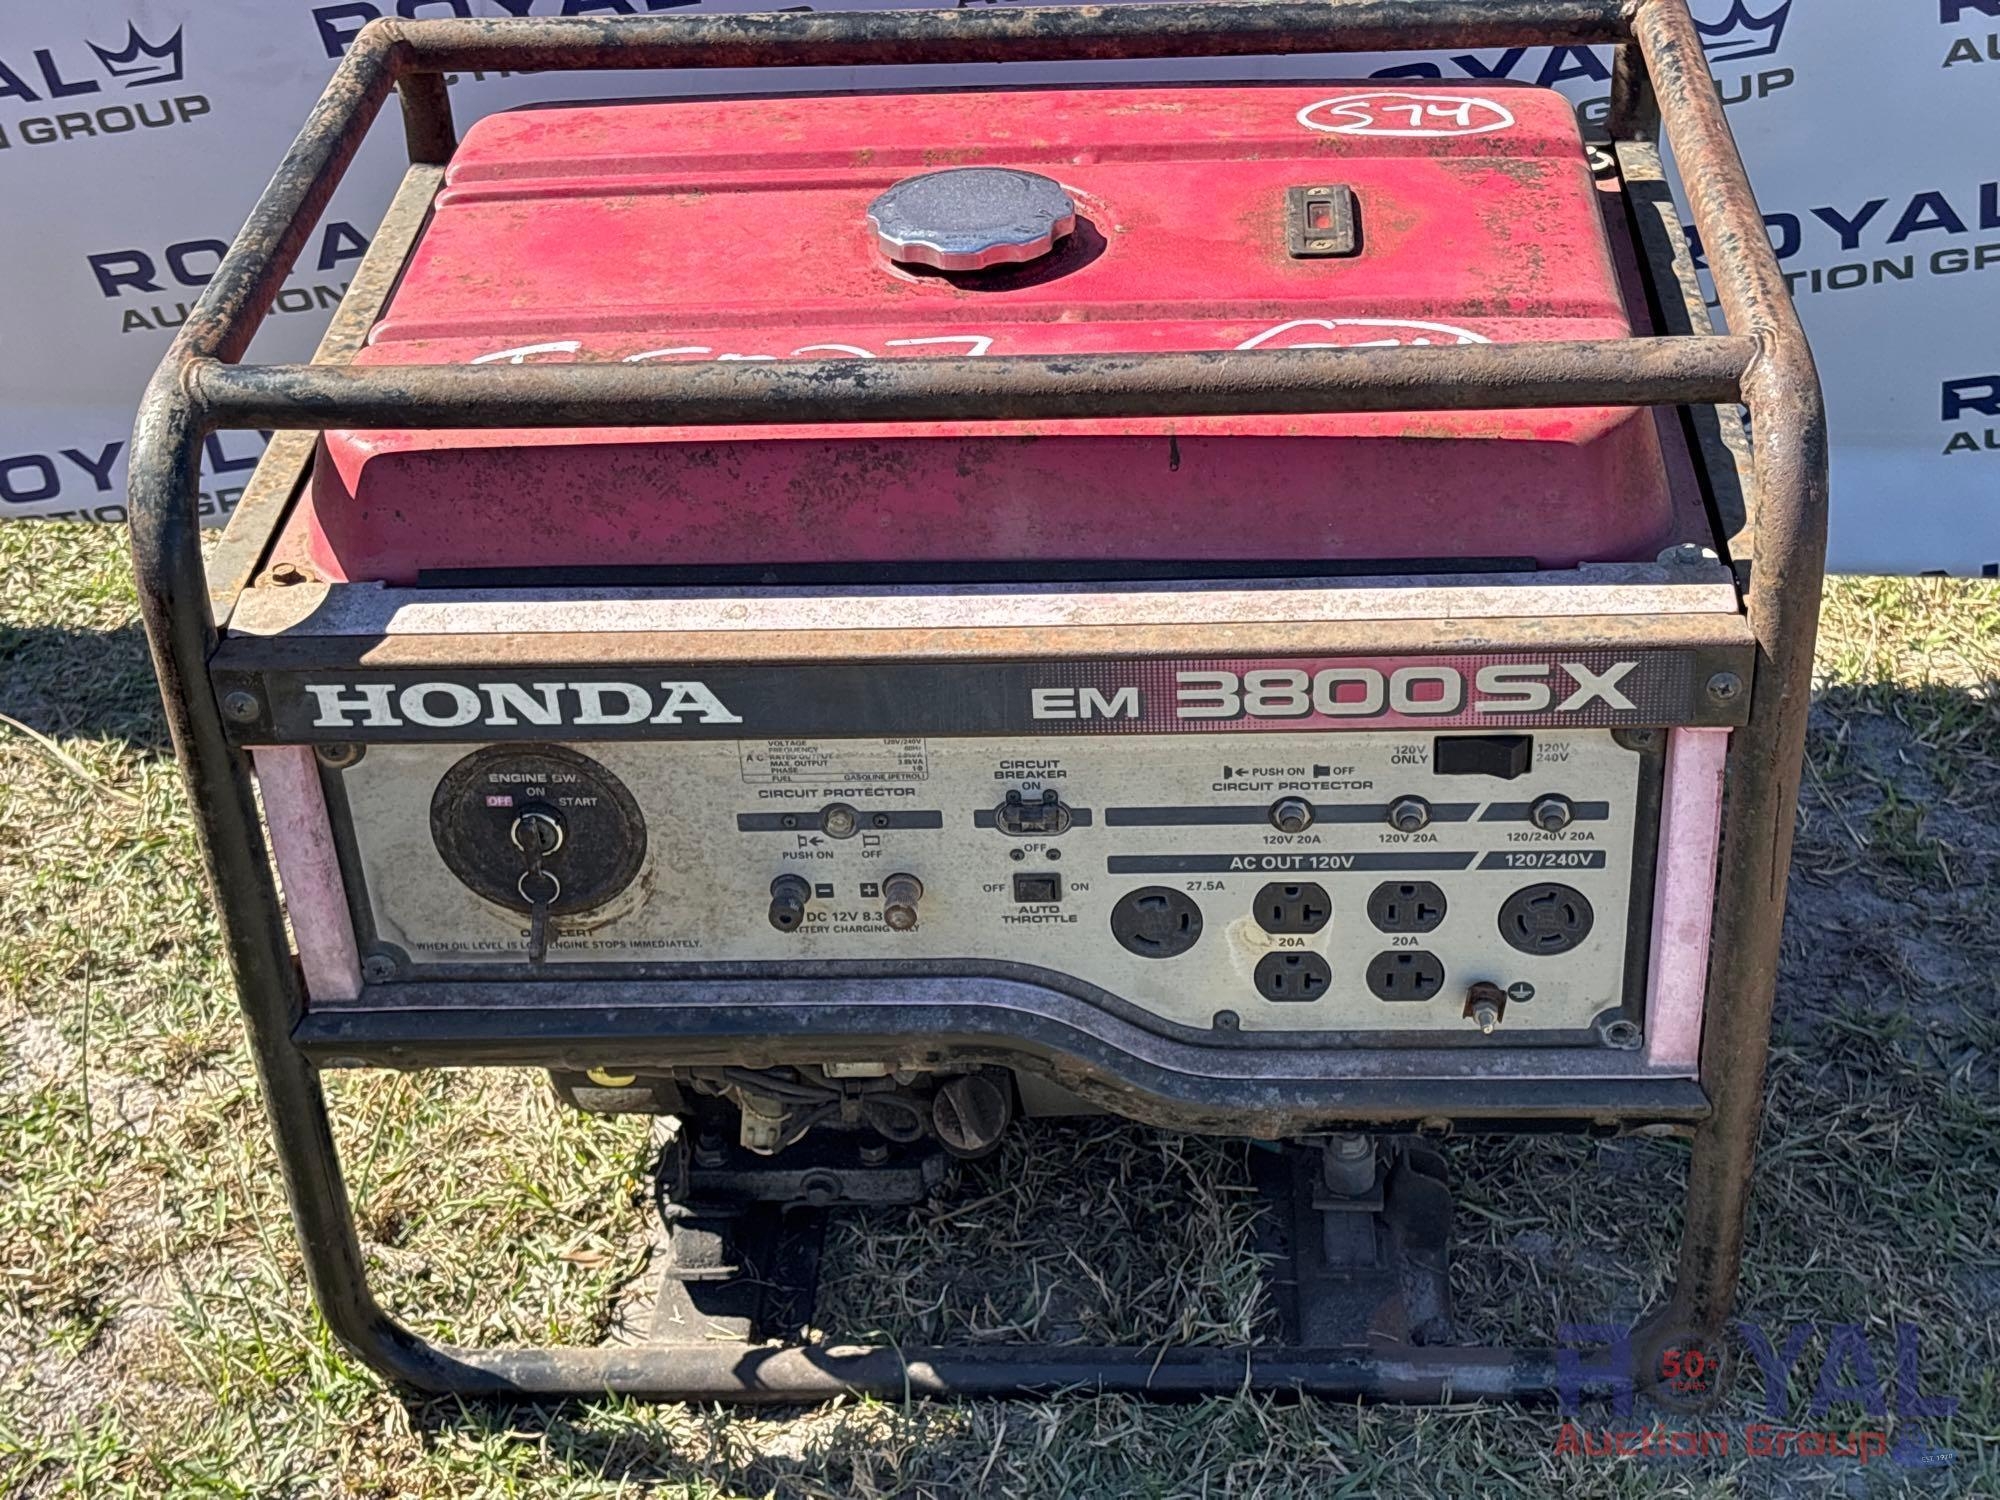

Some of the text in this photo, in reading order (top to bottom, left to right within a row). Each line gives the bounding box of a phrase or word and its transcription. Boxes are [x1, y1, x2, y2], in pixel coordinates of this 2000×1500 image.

[19, 95, 211, 145] GROUP
[305, 682, 744, 728] HONDA
[1031, 687, 1139, 719] EM
[1393, 745, 1426, 755] 120V
[1537, 743, 1570, 752] 120V
[1391, 755, 1428, 765] ONLY
[1536, 753, 1569, 762] 240V
[1000, 760, 1060, 769] CIRCUIT
[994, 770, 1067, 780] BREAKER
[1252, 767, 1305, 776] PUSH ON
[1333, 767, 1355, 775] OFF
[489, 774, 547, 783] ENGINE
[1021, 782, 1041, 791] ON
[1212, 781, 1373, 791] CIRCUIT PROTECTOR
[526, 787, 545, 796] ON
[758, 788, 916, 798] CIRCUIT PROTECTOR
[488, 797, 512, 806] OFF
[558, 797, 598, 807] START
[1263, 835, 1321, 844] 120V 20A
[1379, 833, 1437, 843] 120V 20A
[1507, 831, 1595, 842] 120/240V 20A
[1024, 844, 1047, 852] OFF
[783, 851, 834, 859] PUSH ON
[862, 850, 883, 859] OFF
[1230, 855, 1355, 870] AC OUT 120V
[1505, 853, 1593, 867] 120/240V
[983, 884, 1005, 892] OFF
[1071, 883, 1089, 891] ON
[1186, 881, 1226, 891] 27.5A
[1019, 906, 1060, 914] AUTO
[807, 912, 883, 922] DC 12V 8.3
[1001, 915, 1078, 924] THROTTLE
[833, 925, 889, 933] CHARGING
[416, 942, 449, 950] WHEN
[452, 942, 469, 950] OIL
[472, 942, 504, 950] LEVEL
[593, 940, 626, 949] STOPS
[1278, 937, 1305, 947] 20A
[1391, 936, 1419, 947] 20A
